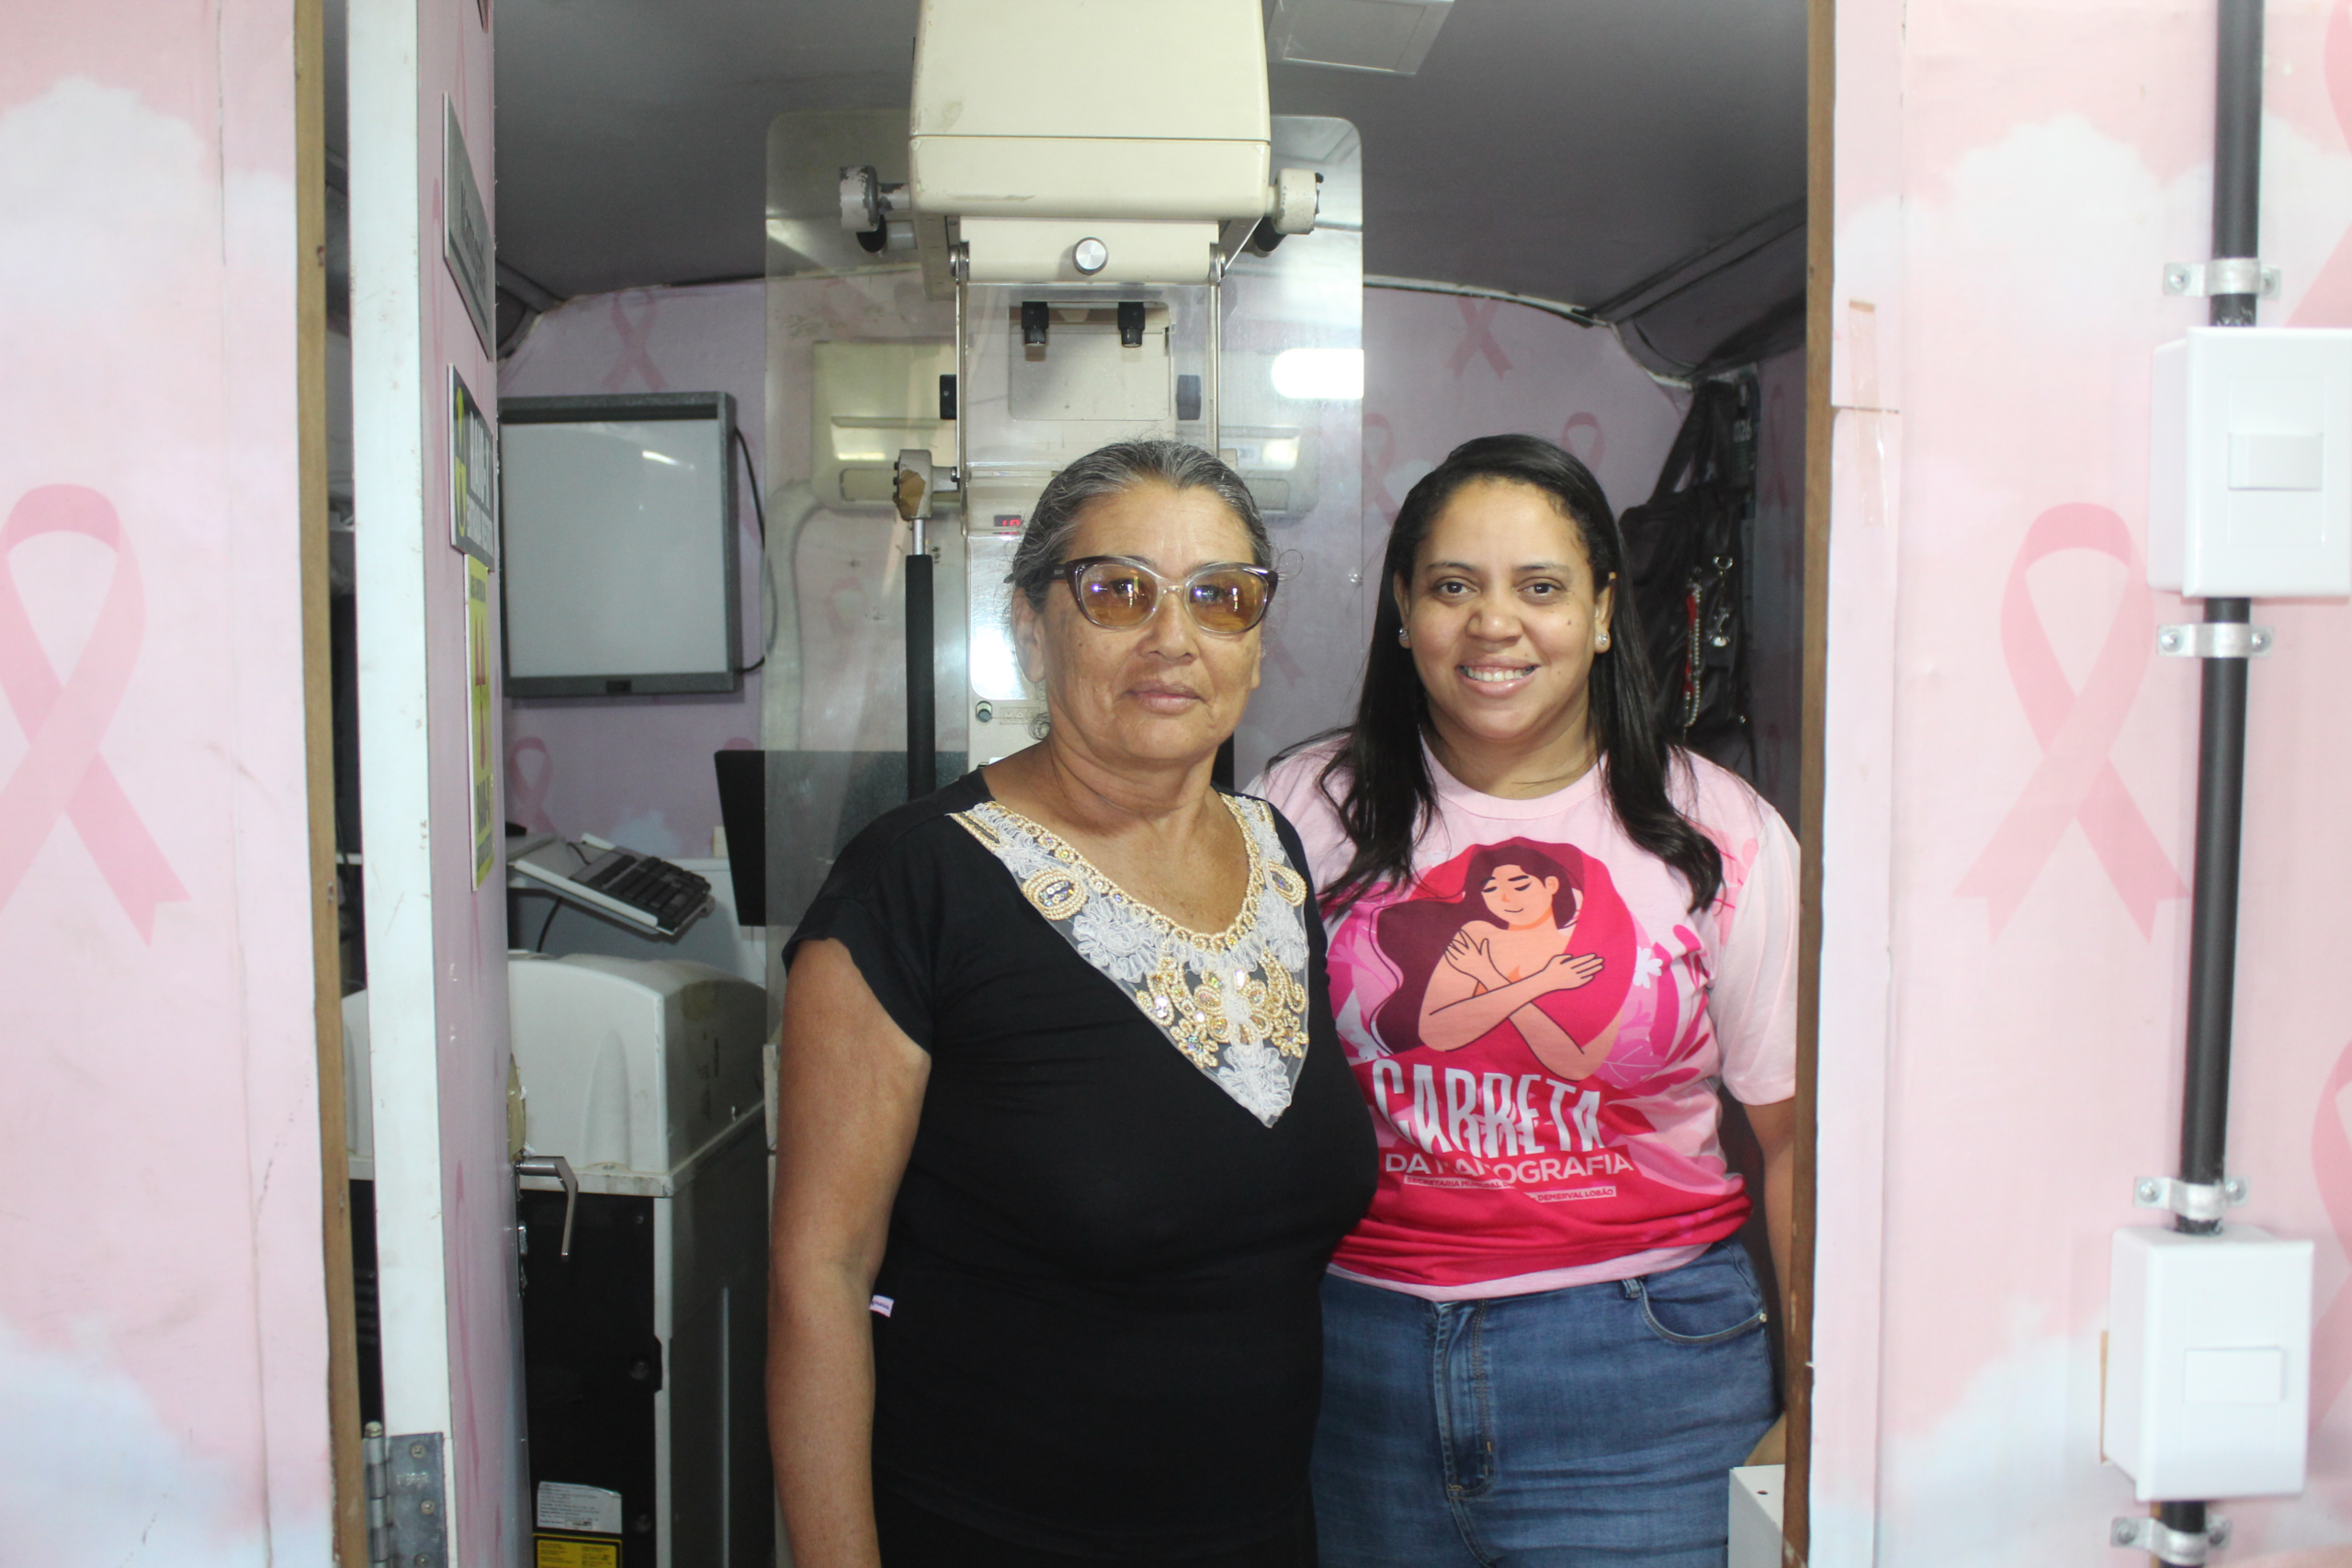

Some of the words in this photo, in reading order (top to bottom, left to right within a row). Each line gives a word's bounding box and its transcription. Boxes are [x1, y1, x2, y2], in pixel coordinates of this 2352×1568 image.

[1372, 1059, 1606, 1158] CARRETA
[1385, 1153, 1432, 1175] DA
[1407, 1177, 1461, 1188] SECRETARIA
[1537, 1191, 1584, 1201] DEMERVAL
[1585, 1188, 1614, 1198] LOBÃO
